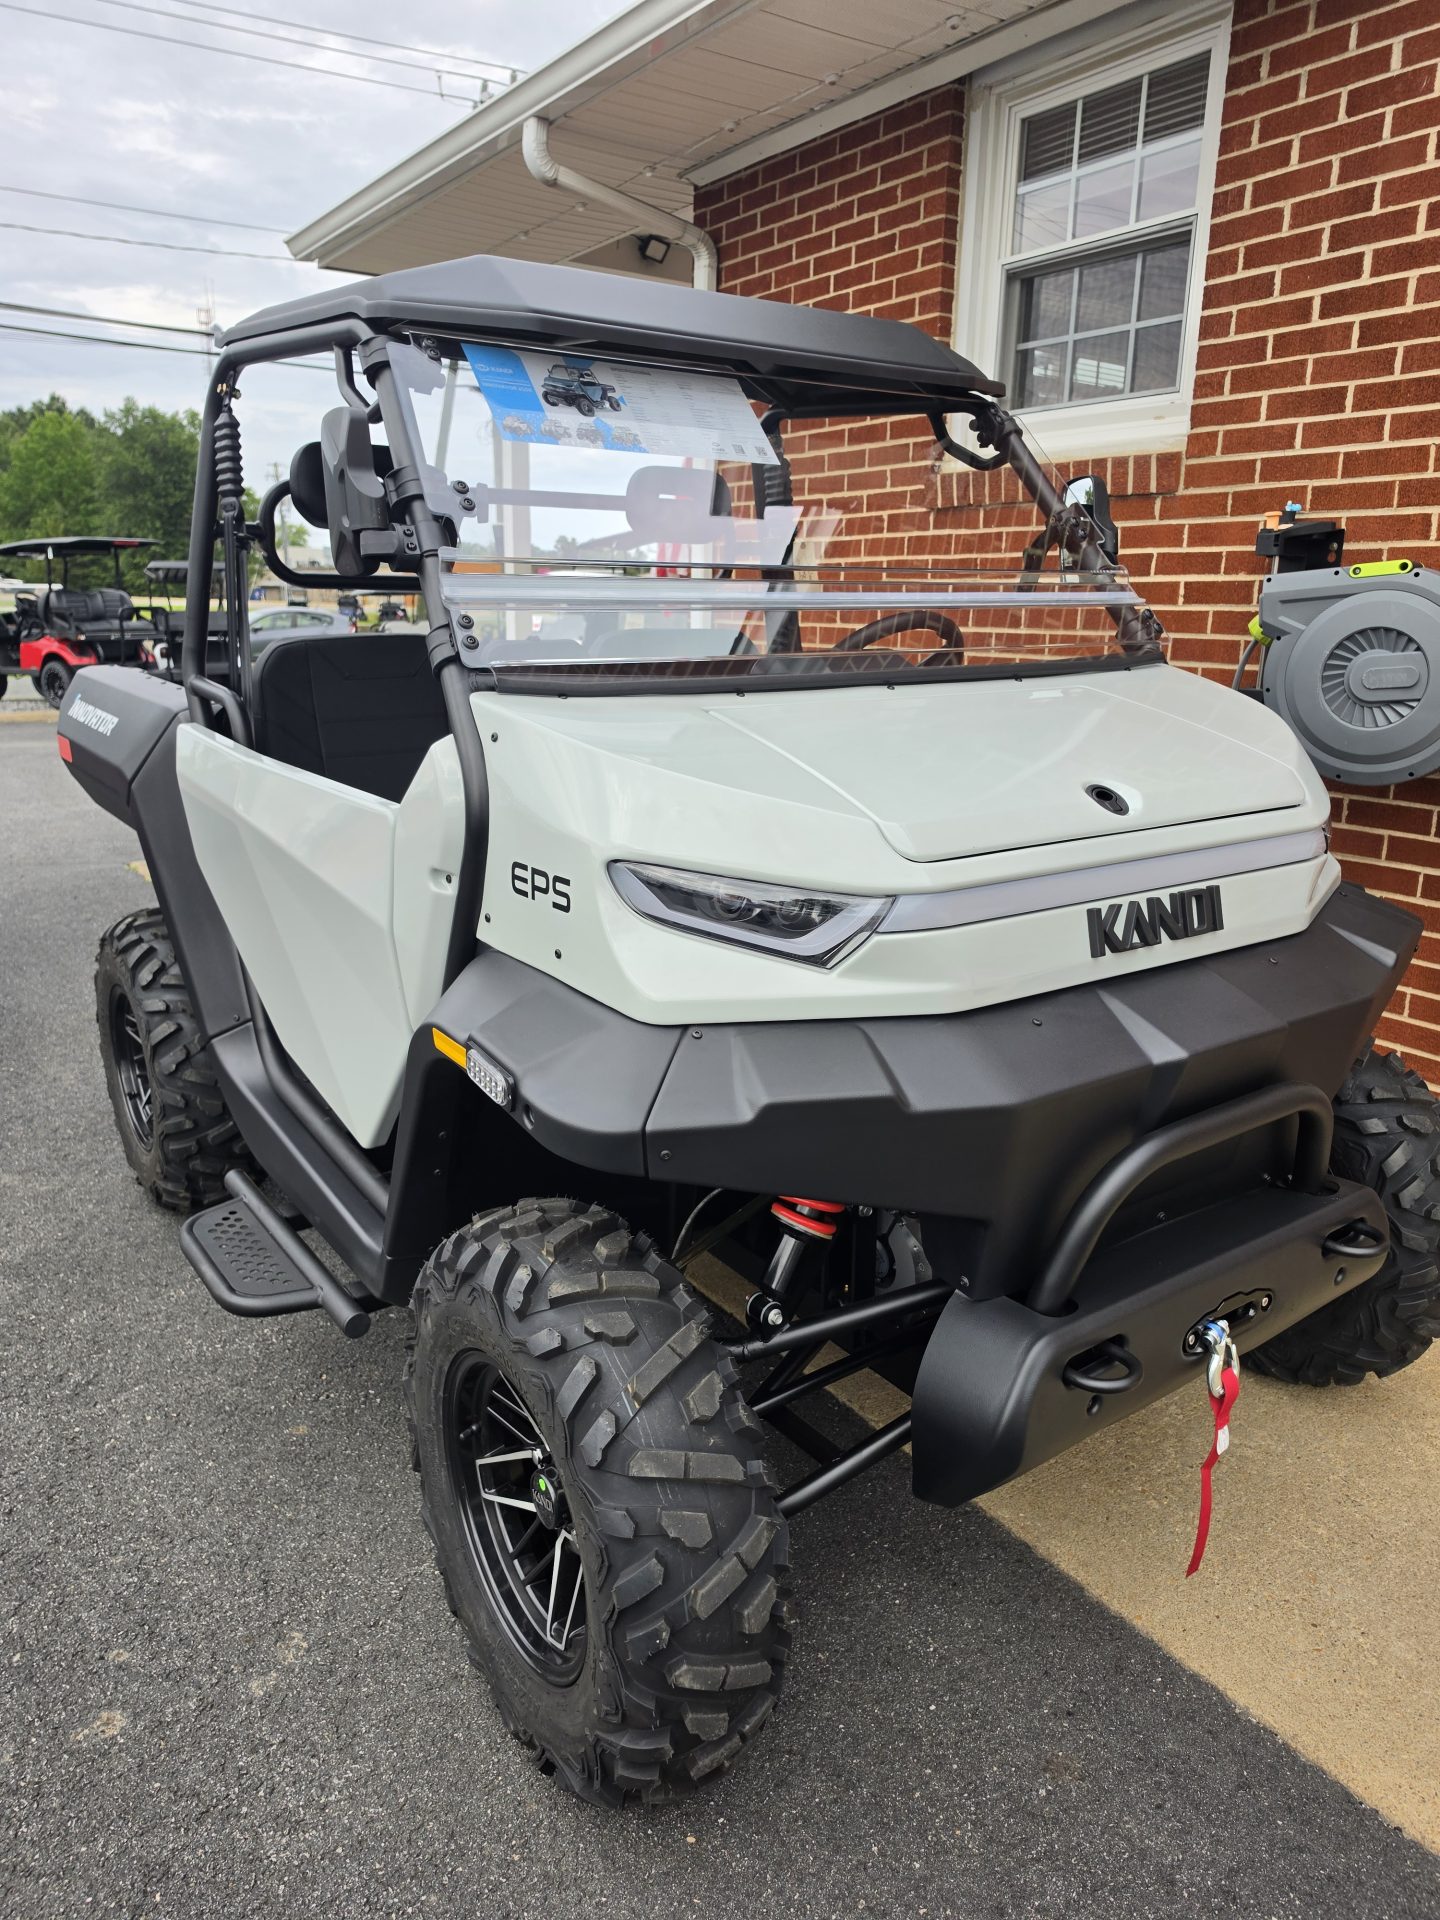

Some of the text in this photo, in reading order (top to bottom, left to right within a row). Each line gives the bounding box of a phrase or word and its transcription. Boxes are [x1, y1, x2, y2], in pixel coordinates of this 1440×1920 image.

[67, 693, 120, 737] INNOVATOR
[511, 861, 571, 914] EPS
[1086, 884, 1225, 958] KANDI
[531, 1487, 554, 1515] KANDI
